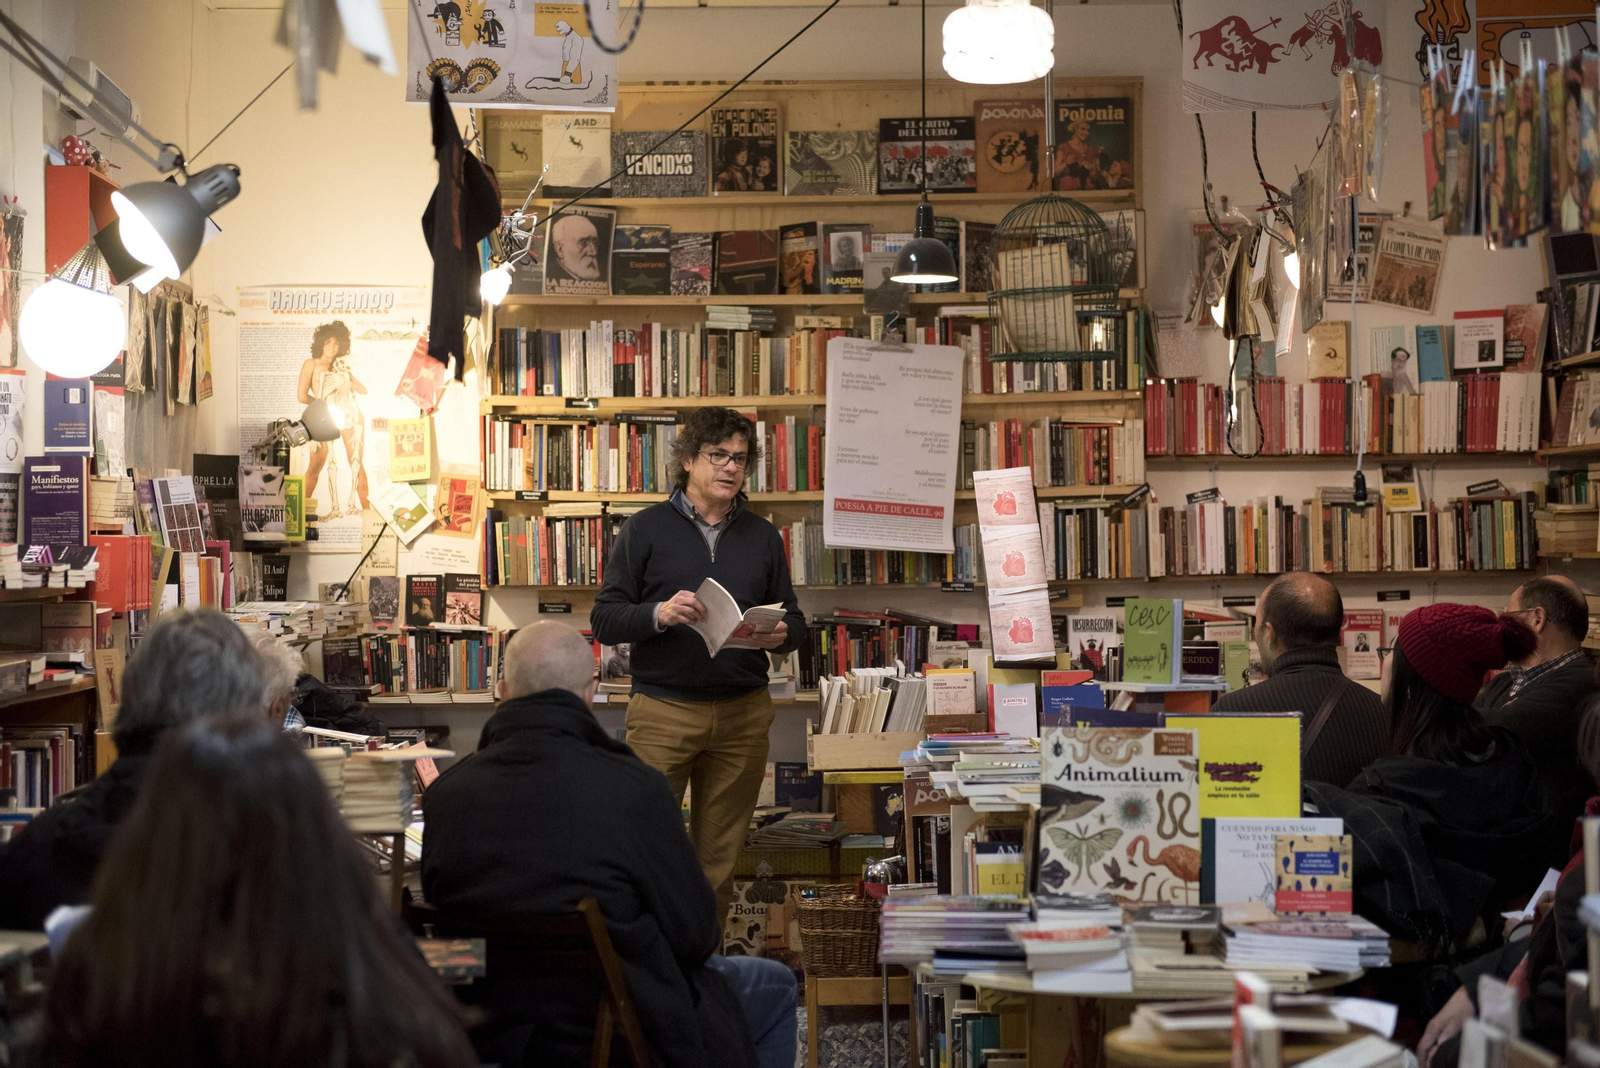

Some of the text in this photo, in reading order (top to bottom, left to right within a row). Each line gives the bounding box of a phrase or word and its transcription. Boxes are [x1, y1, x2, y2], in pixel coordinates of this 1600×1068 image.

[1059, 106, 1124, 120] Polonia
[712, 123, 776, 137] EN POLONIA
[625, 154, 693, 175] VENCIDXS
[547, 278, 558, 286] LA
[270, 290, 394, 310] HANGUEANDO
[31, 475, 79, 484] Manifiestos
[194, 476, 234, 485] OPHELIA
[242, 509, 284, 522] HILDEGART
[903, 507, 932, 517] CALLE,
[264, 565, 285, 574] El Anti
[1073, 616, 1113, 631] INSURRECCIÓN
[1055, 762, 1184, 782] Animalium
[991, 874, 1009, 885] EL
